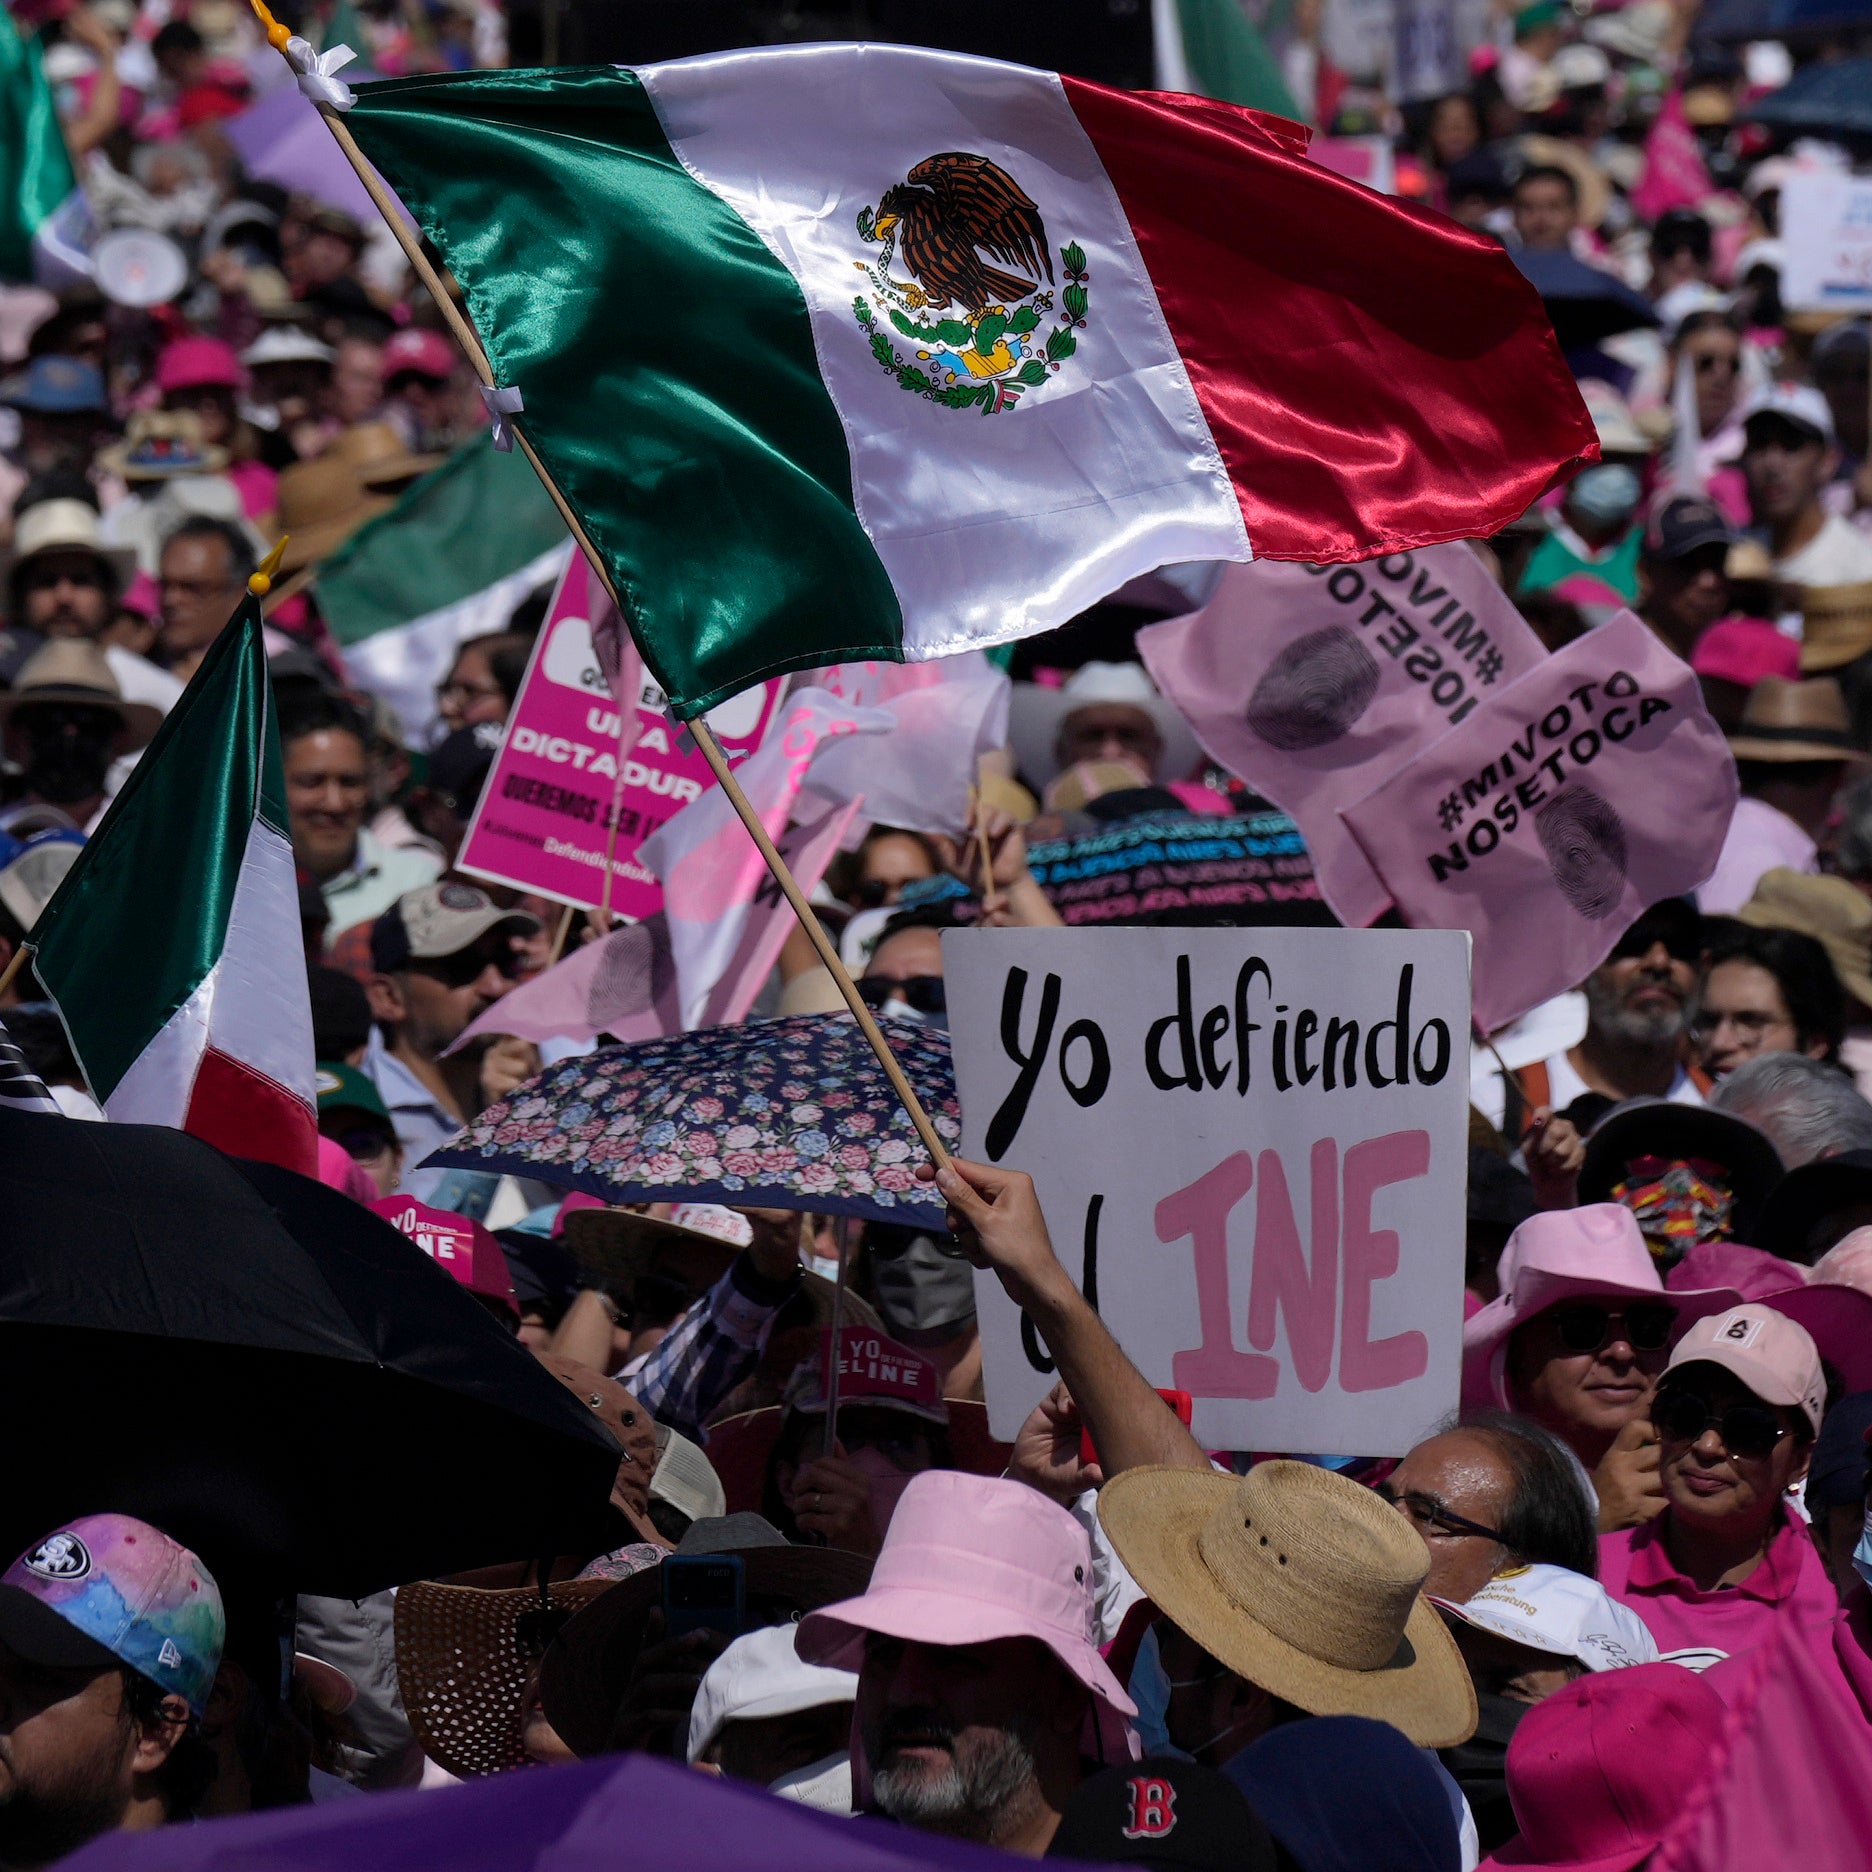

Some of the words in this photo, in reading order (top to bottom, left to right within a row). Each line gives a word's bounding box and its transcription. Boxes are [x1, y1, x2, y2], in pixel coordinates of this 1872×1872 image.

[511, 727, 703, 804] DICTADUR
[1427, 696, 1672, 882] NOSETOCA
[1437, 670, 1639, 832] #MIVOTO
[984, 965, 1111, 1163] Yo
[1144, 954, 1452, 1097] defiendo
[408, 1234, 456, 1260] NE
[1154, 1129, 1431, 1401] INE
[849, 1339, 881, 1359] YO
[867, 1361, 920, 1386] INE
[1122, 1775, 1177, 1840] B
